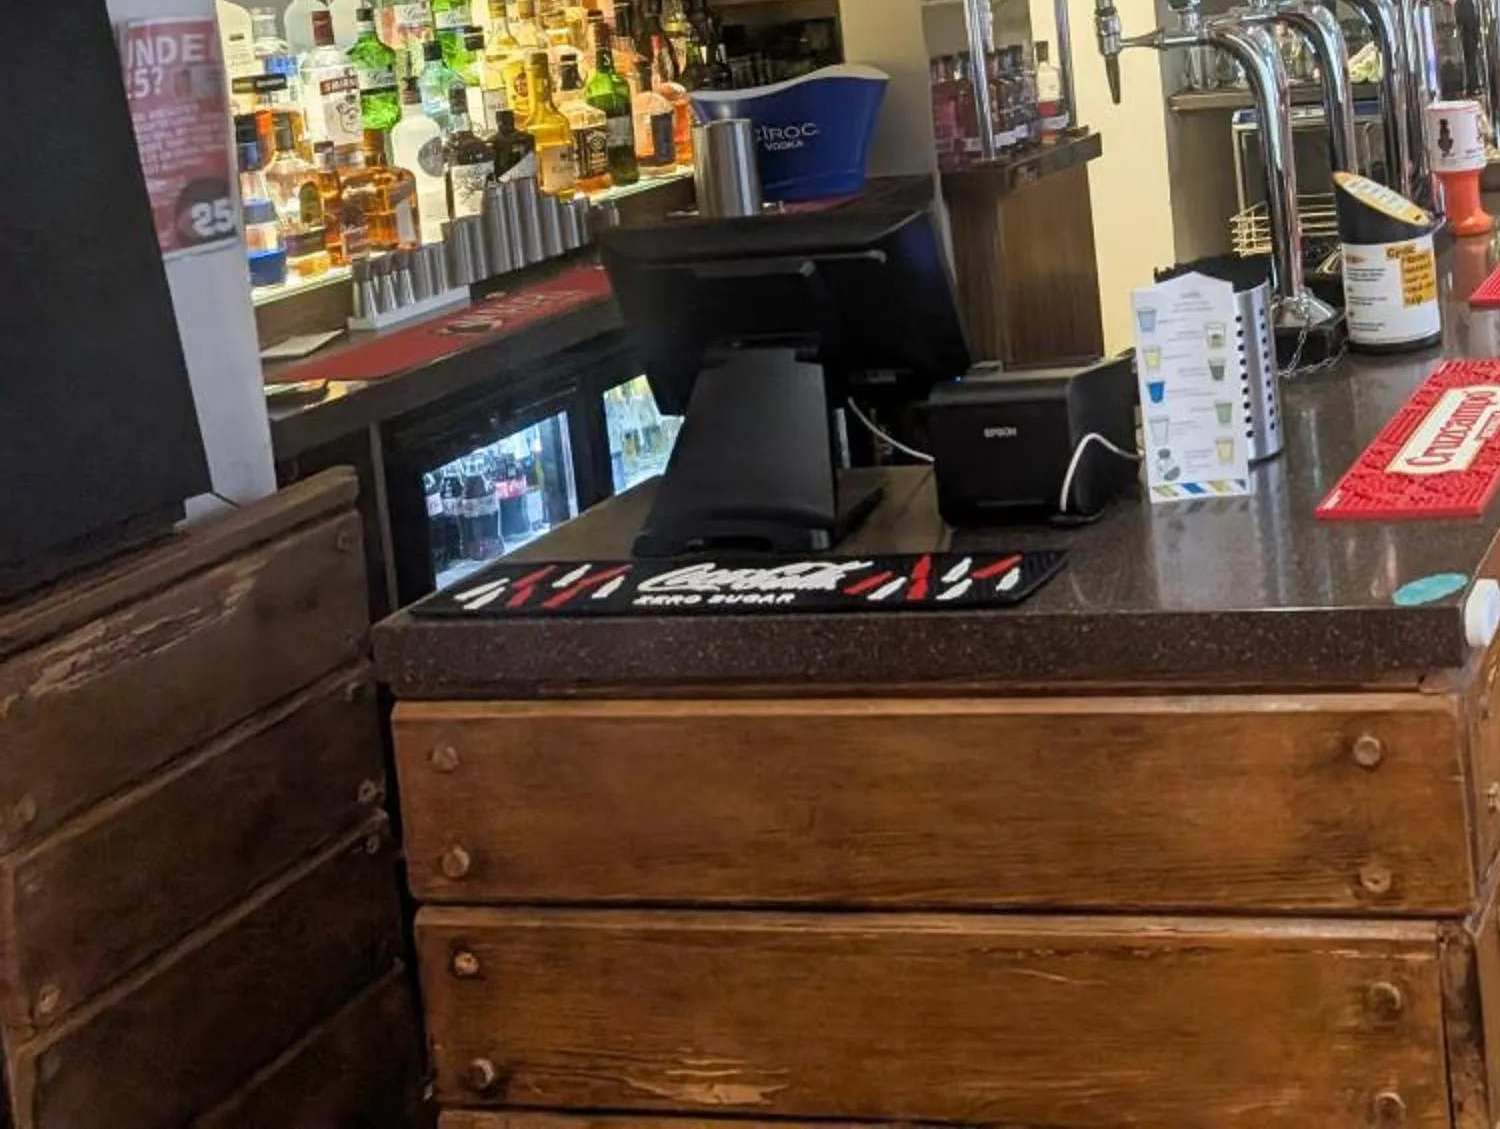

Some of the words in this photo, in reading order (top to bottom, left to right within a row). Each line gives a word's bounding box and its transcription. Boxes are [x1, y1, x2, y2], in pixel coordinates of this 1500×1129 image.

[128, 67, 164, 100] 5?
[191, 197, 234, 237] 25
[1404, 390, 1499, 468] Cruzcampo
[632, 594, 702, 606] ZERO
[707, 592, 796, 605] SUGAR
